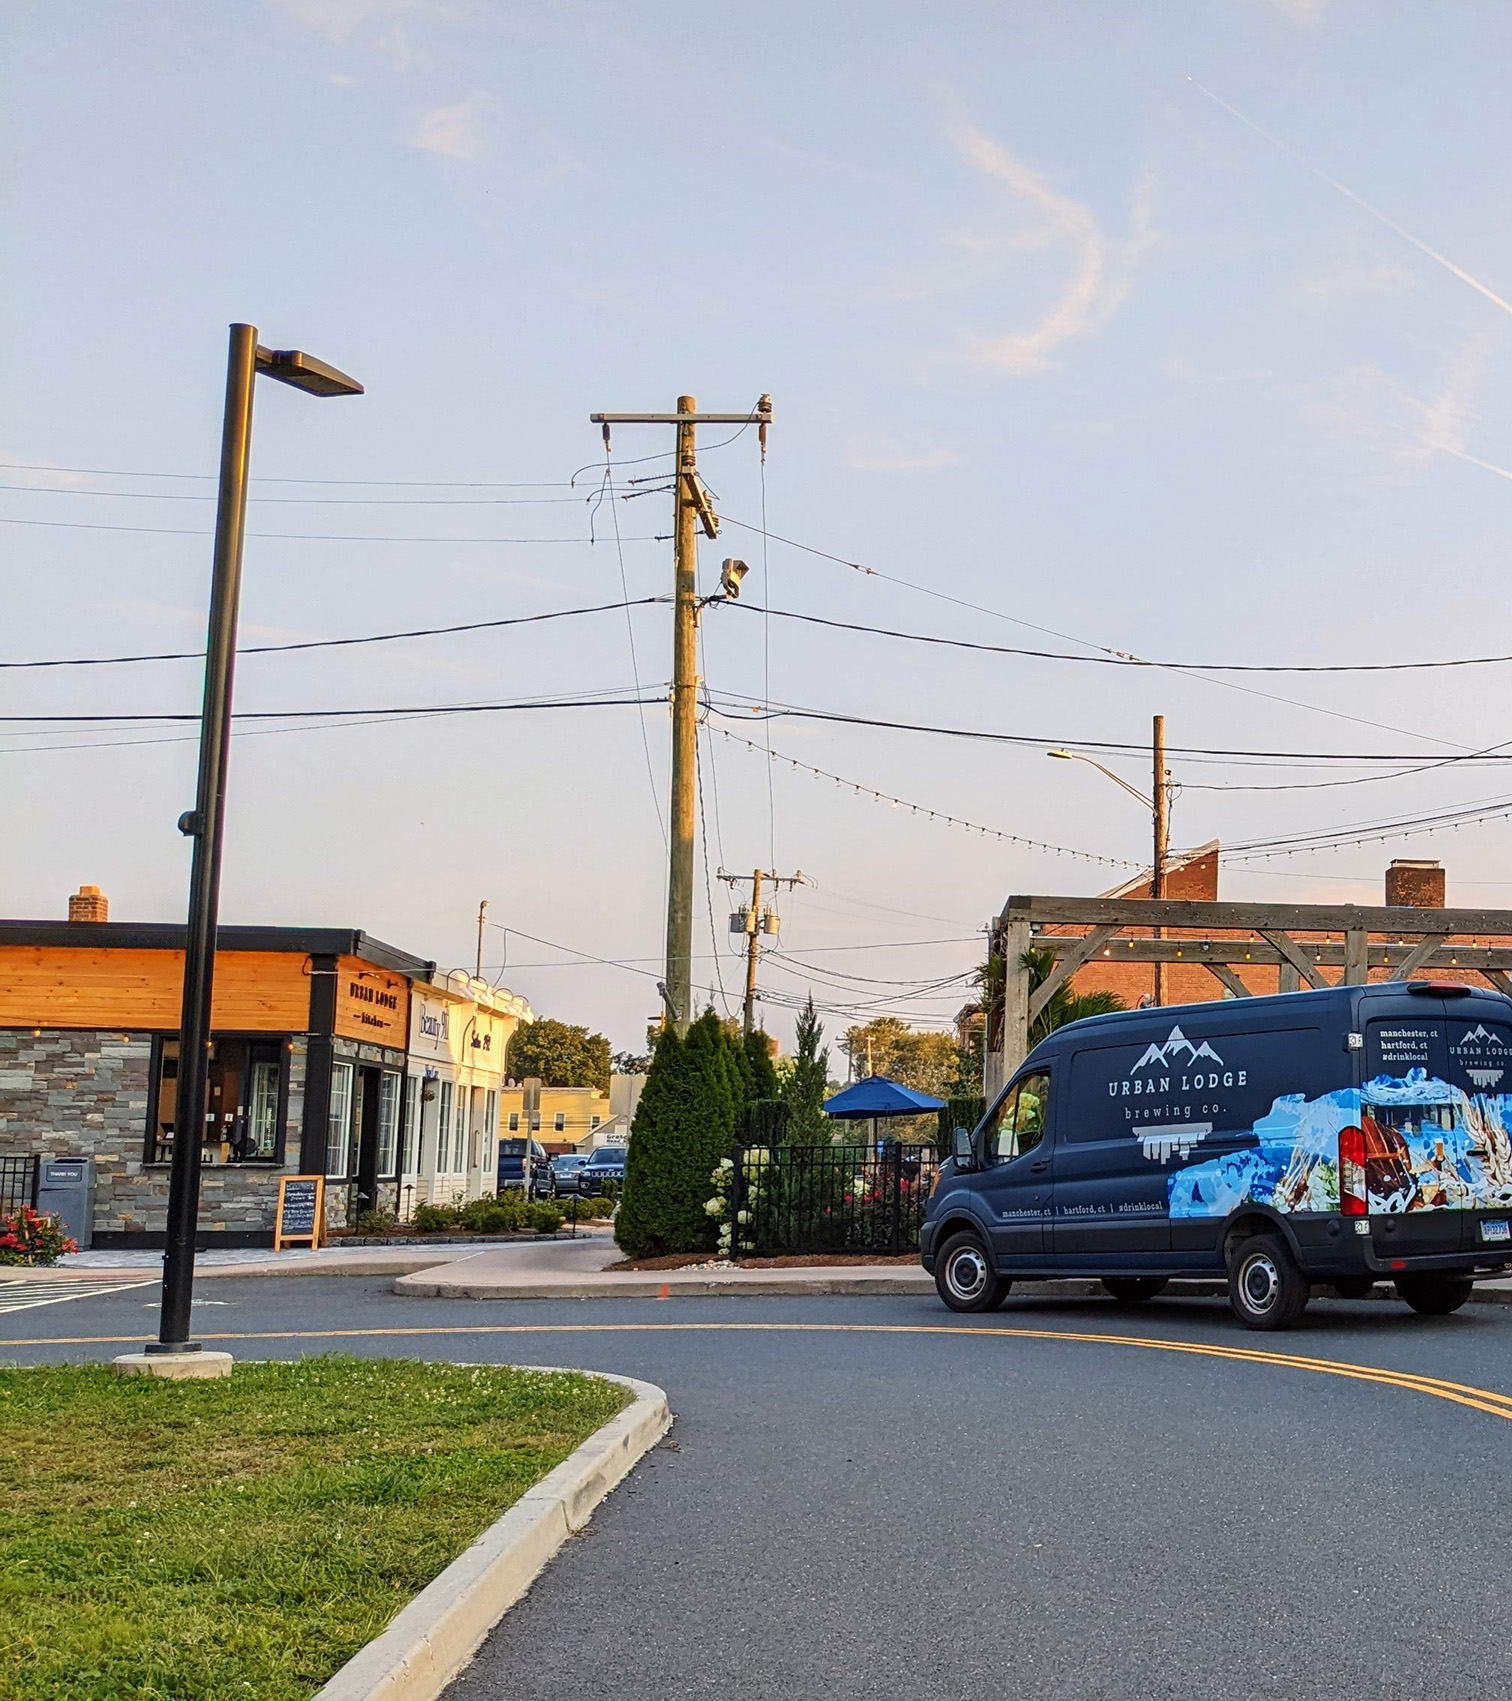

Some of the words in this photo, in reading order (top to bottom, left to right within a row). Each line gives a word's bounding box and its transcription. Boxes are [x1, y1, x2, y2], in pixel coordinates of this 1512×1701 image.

[350, 982, 373, 1003] URBAN
[375, 990, 398, 1010] LODGE
[361, 1012, 384, 1028] kitchen
[1380, 1029, 1429, 1038] manchester,
[1430, 1030, 1438, 1038] ct
[1381, 1040, 1418, 1050] hartford,
[1450, 1046, 1481, 1055] URBAN
[1486, 1047, 1512, 1056] LODGE
[1382, 1052, 1428, 1061] #drinklocal
[1459, 1059, 1493, 1067] brewing
[1109, 1078, 1170, 1096] URBAN
[1182, 1071, 1247, 1090] LODGE
[1125, 1104, 1191, 1119] brewing
[1202, 1104, 1227, 1114] co.
[1064, 1205, 1097, 1215] hartford,
[1098, 1204, 1106, 1213] ct
[1119, 1201, 1163, 1212] #drinklocal
[1002, 1210, 1043, 1218] manchester,
